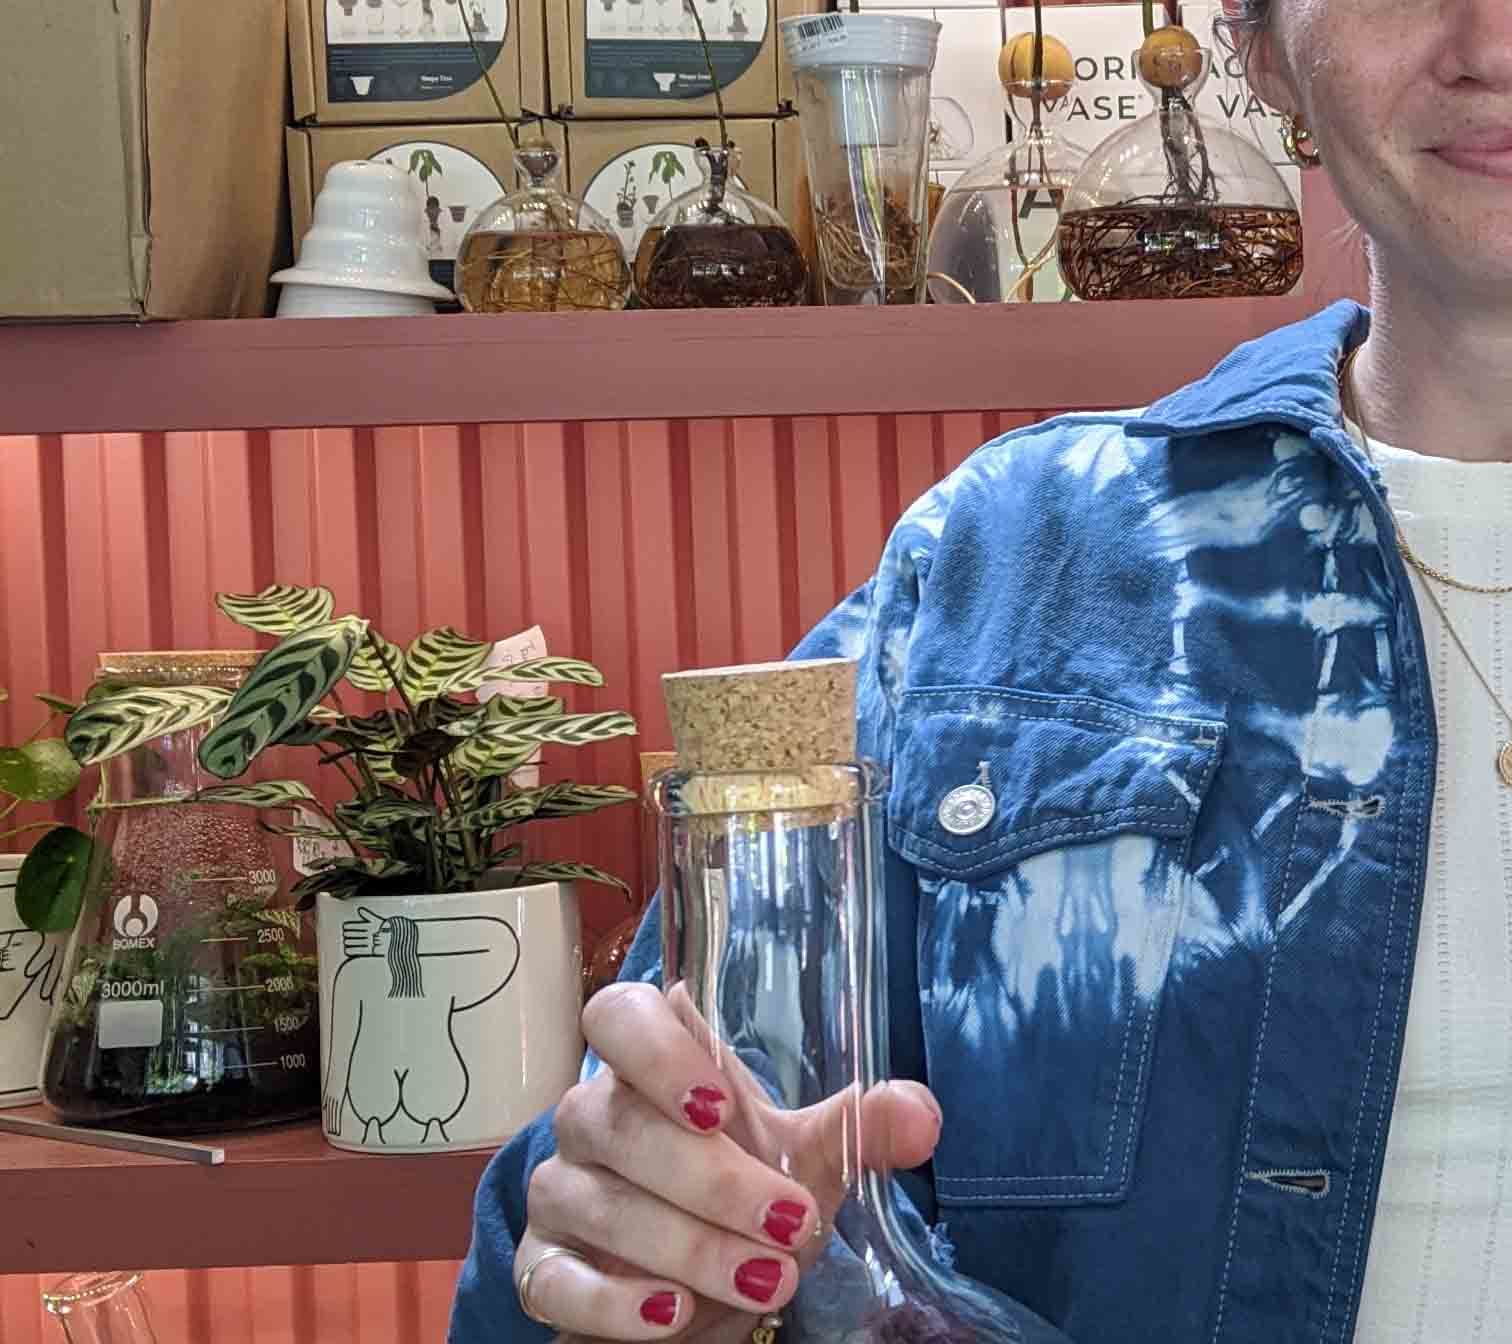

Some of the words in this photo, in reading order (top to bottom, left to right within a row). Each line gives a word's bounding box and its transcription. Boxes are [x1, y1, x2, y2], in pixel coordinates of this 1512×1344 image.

[249, 870, 276, 884] 3000
[257, 928, 285, 944] 2500
[101, 980, 164, 999] 3000ml
[280, 1054, 306, 1069] 1000
